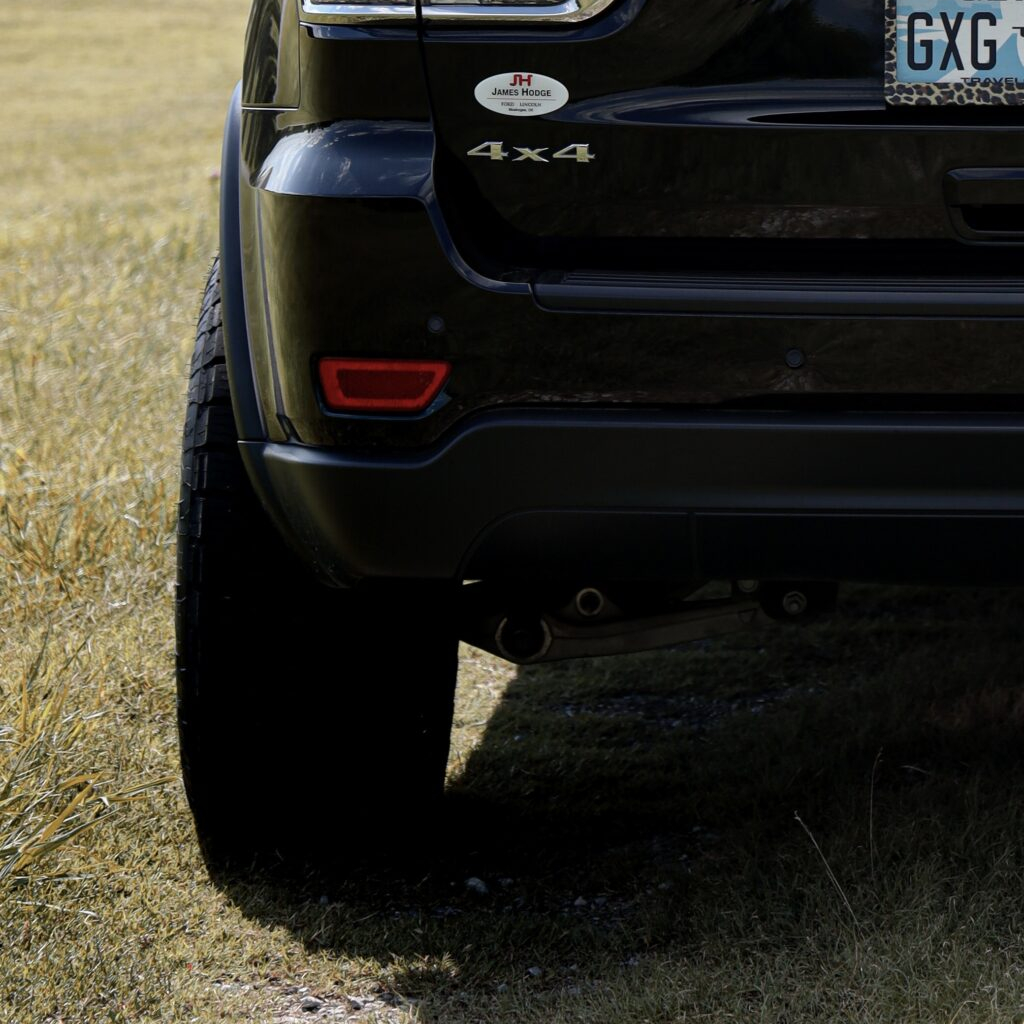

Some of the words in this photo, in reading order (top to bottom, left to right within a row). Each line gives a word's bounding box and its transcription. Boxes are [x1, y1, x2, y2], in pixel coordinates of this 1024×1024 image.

[907, 11, 998, 71] GXG
[491, 87, 519, 97] JAMES
[521, 88, 552, 97] HODGE
[467, 141, 596, 163] 4x4
